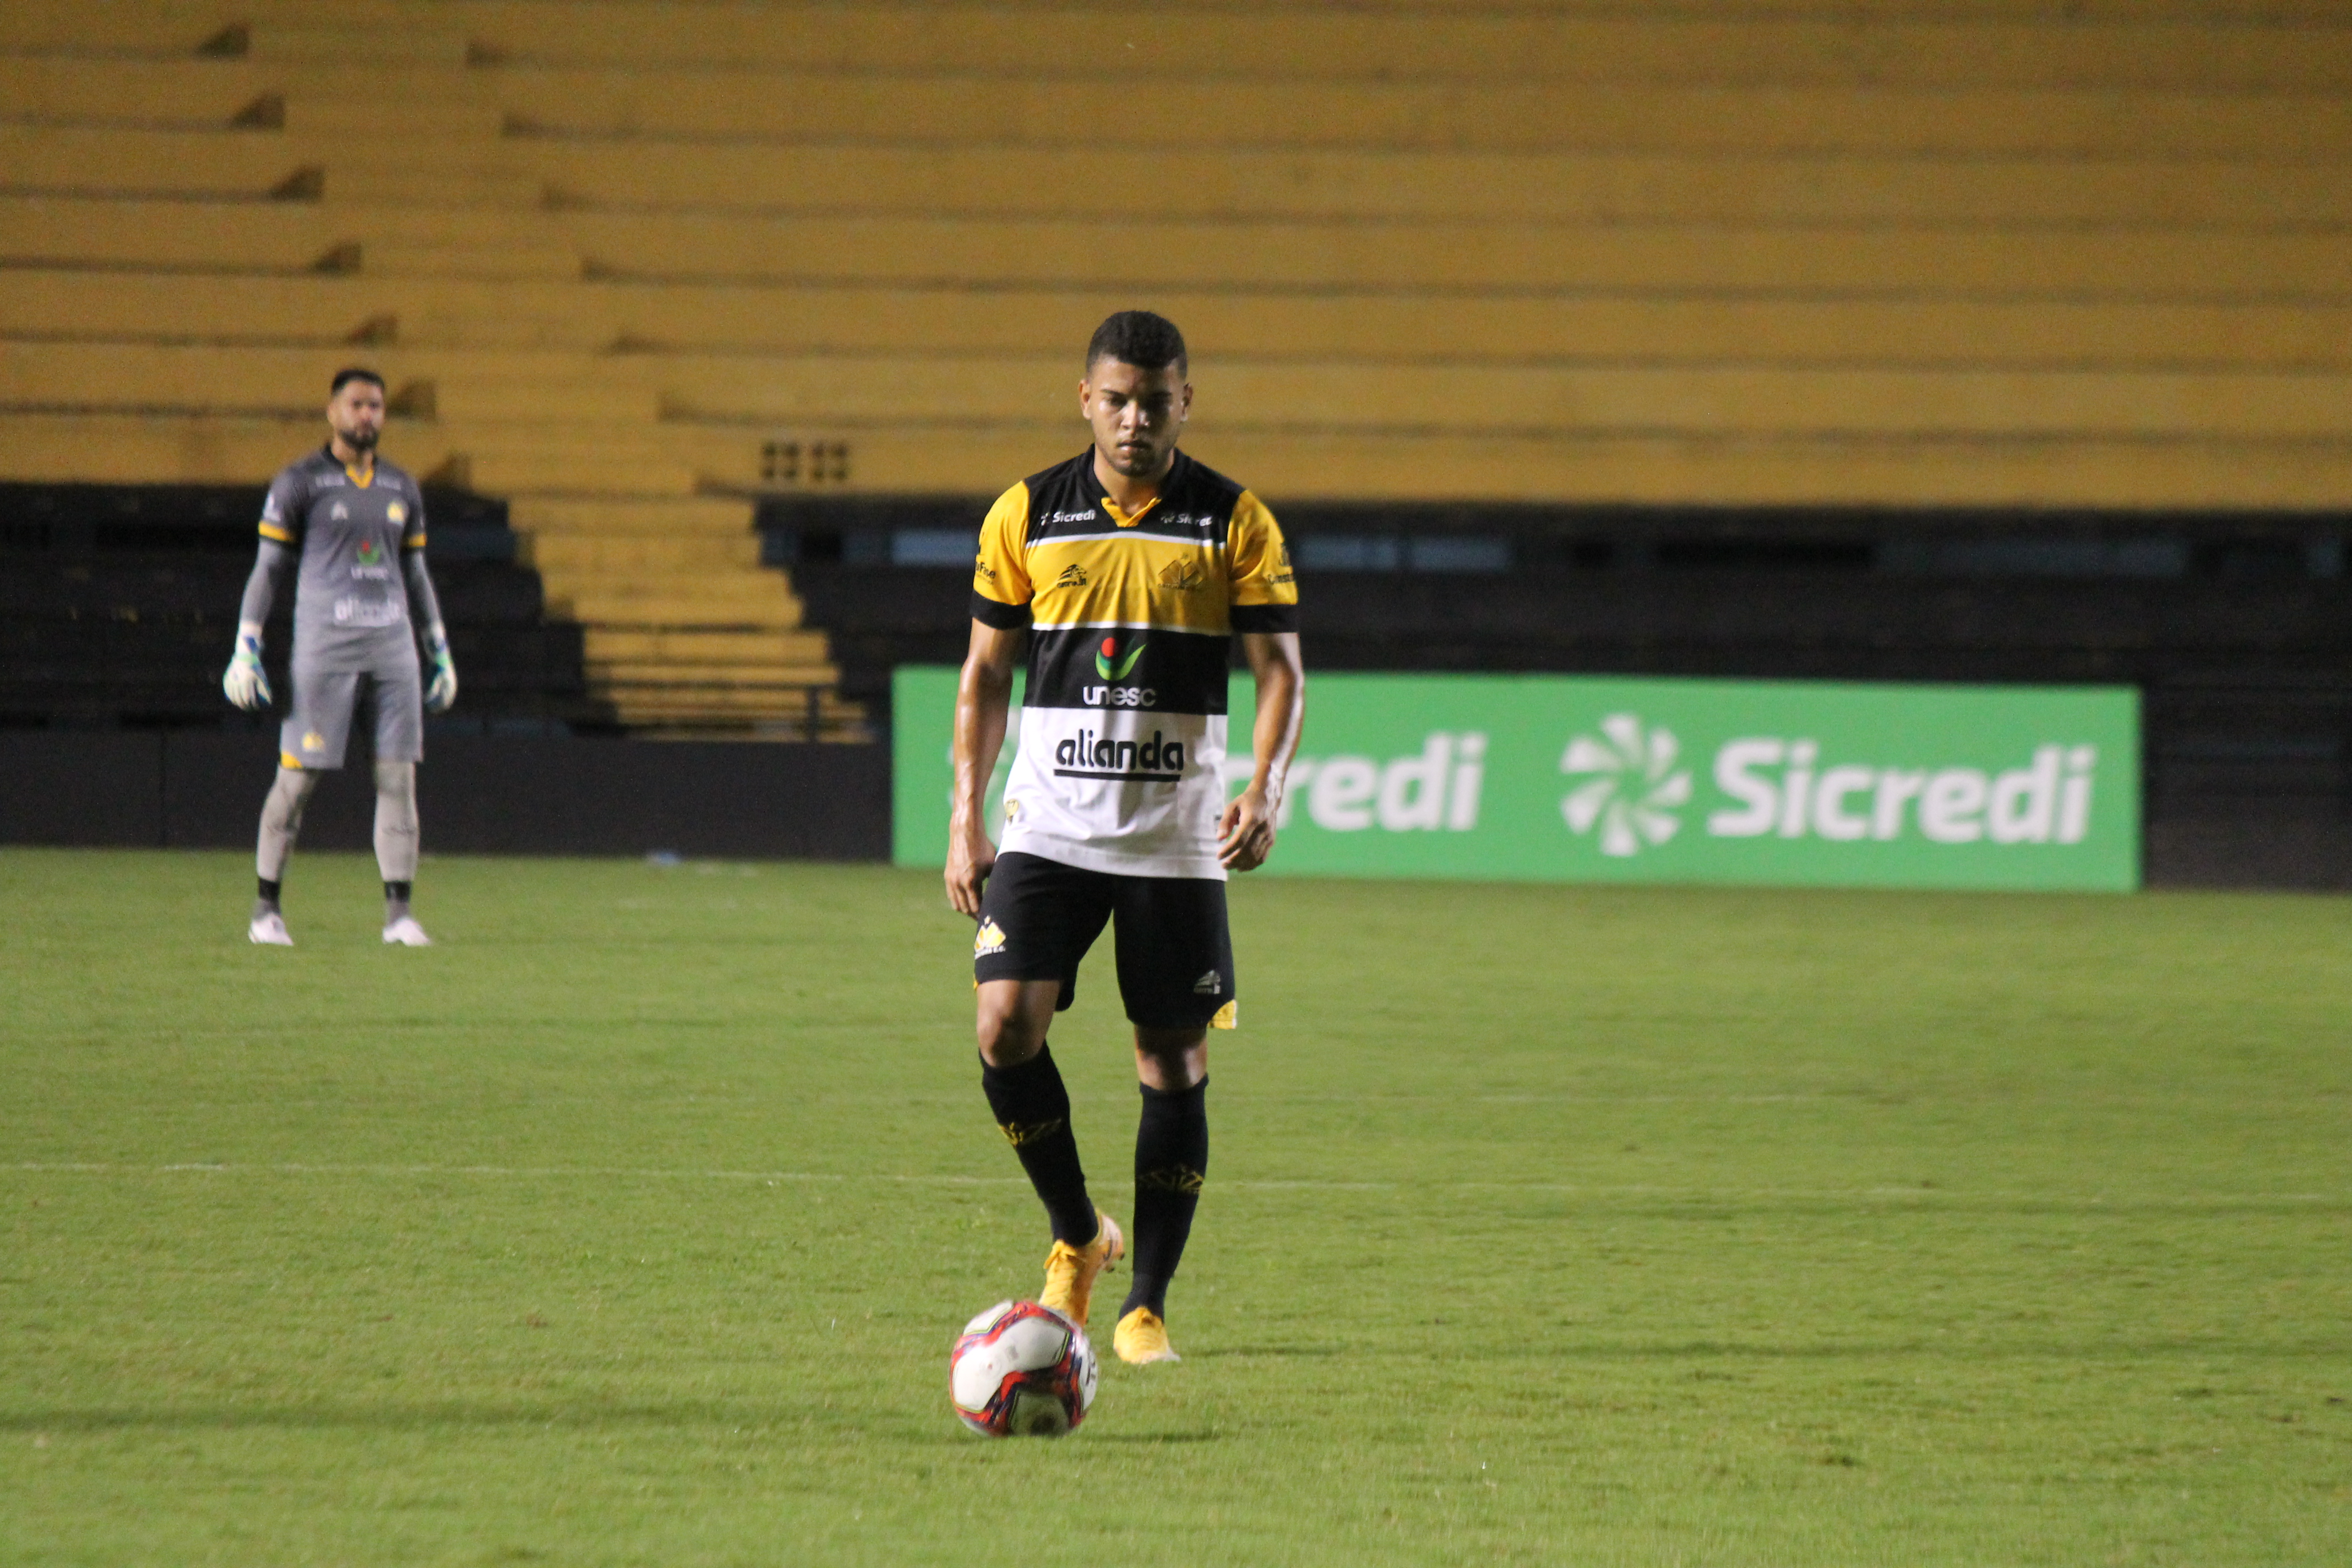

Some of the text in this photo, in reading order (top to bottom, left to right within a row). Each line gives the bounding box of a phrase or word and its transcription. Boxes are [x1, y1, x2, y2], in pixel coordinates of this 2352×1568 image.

[1052, 509, 1096, 523] Sicredi
[1083, 686, 1156, 707] unesc
[1055, 728, 1184, 771] alianda
[1708, 736, 2097, 843] Sicredi
